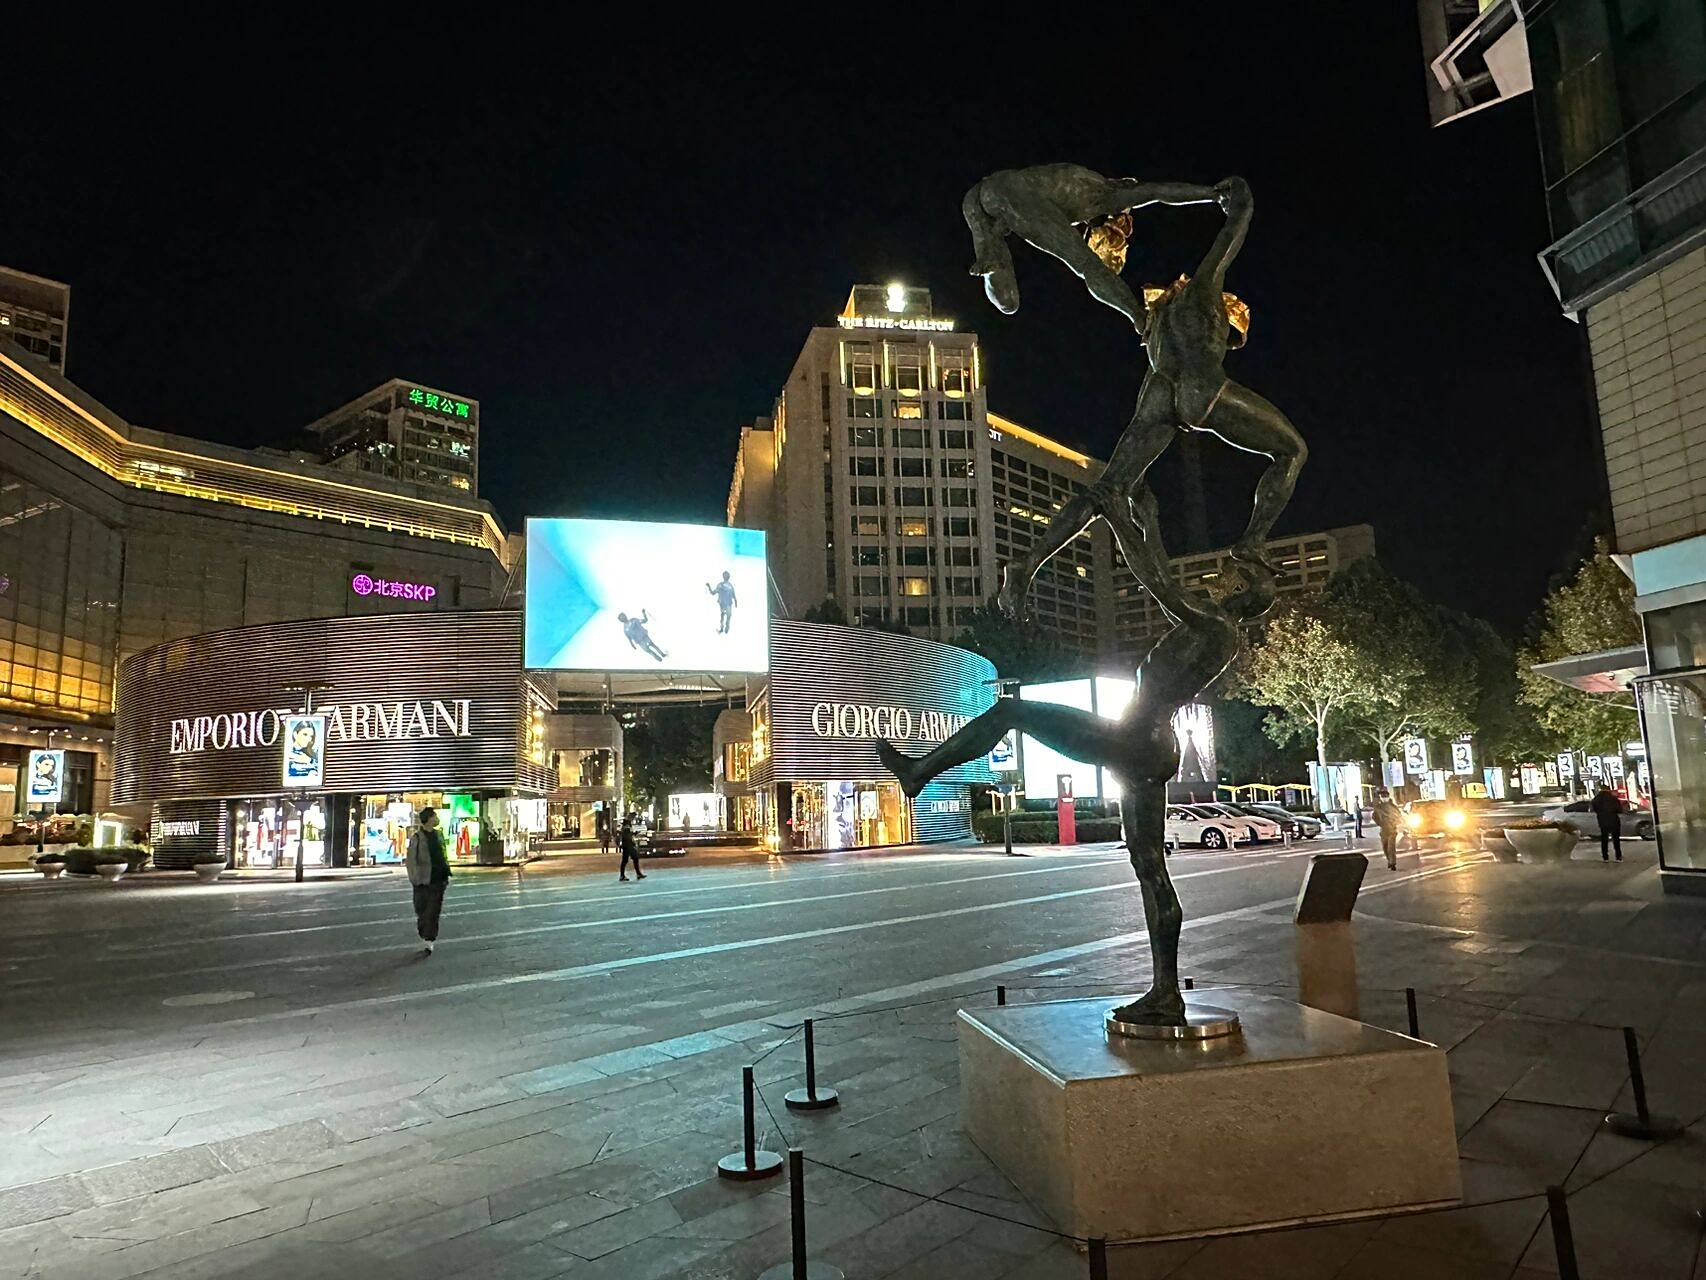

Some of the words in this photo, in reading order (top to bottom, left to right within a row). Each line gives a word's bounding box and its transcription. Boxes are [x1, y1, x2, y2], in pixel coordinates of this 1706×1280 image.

[838, 315, 863, 329] THE
[409, 389, 469, 418] 华贸公寓
[170, 708, 280, 754] EMPORIO
[326, 699, 472, 741] ARMANI
[811, 702, 912, 739] GIORGIO
[917, 709, 975, 742] ARMA
